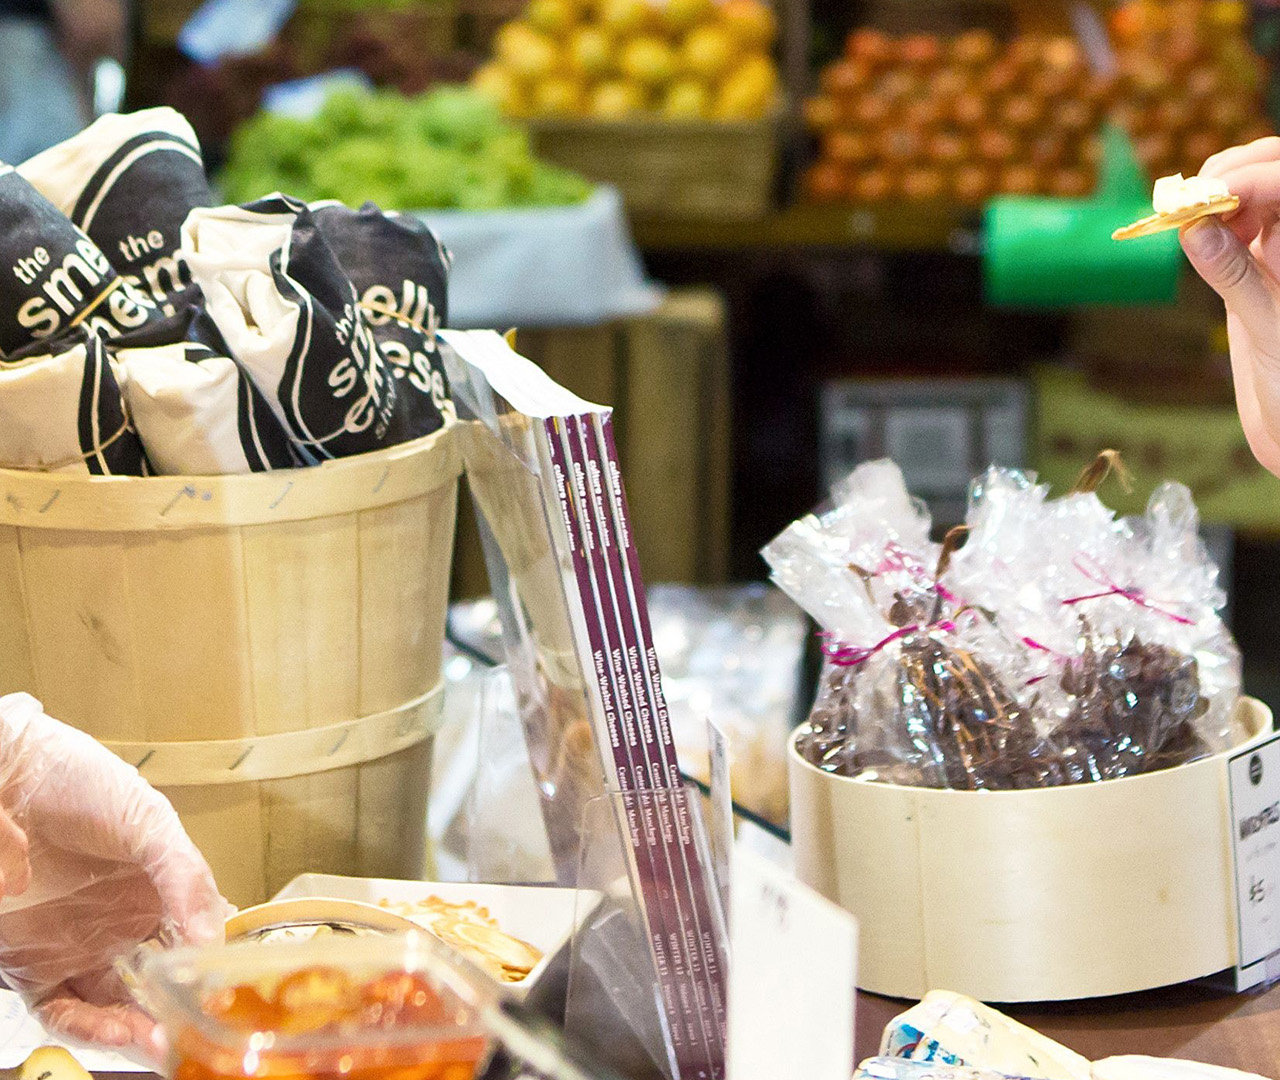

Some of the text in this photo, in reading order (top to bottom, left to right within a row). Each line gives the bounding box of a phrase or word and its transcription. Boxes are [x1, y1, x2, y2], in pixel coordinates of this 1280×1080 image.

[119, 230, 164, 264] the
[13, 245, 51, 286] the
[554, 464, 566, 498] culture
[574, 462, 586, 496] culture
[589, 460, 602, 494] culture
[610, 461, 621, 494] culture
[607, 712, 620, 748] Cheeses
[624, 711, 637, 746] Cheeses
[641, 708, 653, 744] Cheeses
[660, 710, 671, 746] Cheeses
